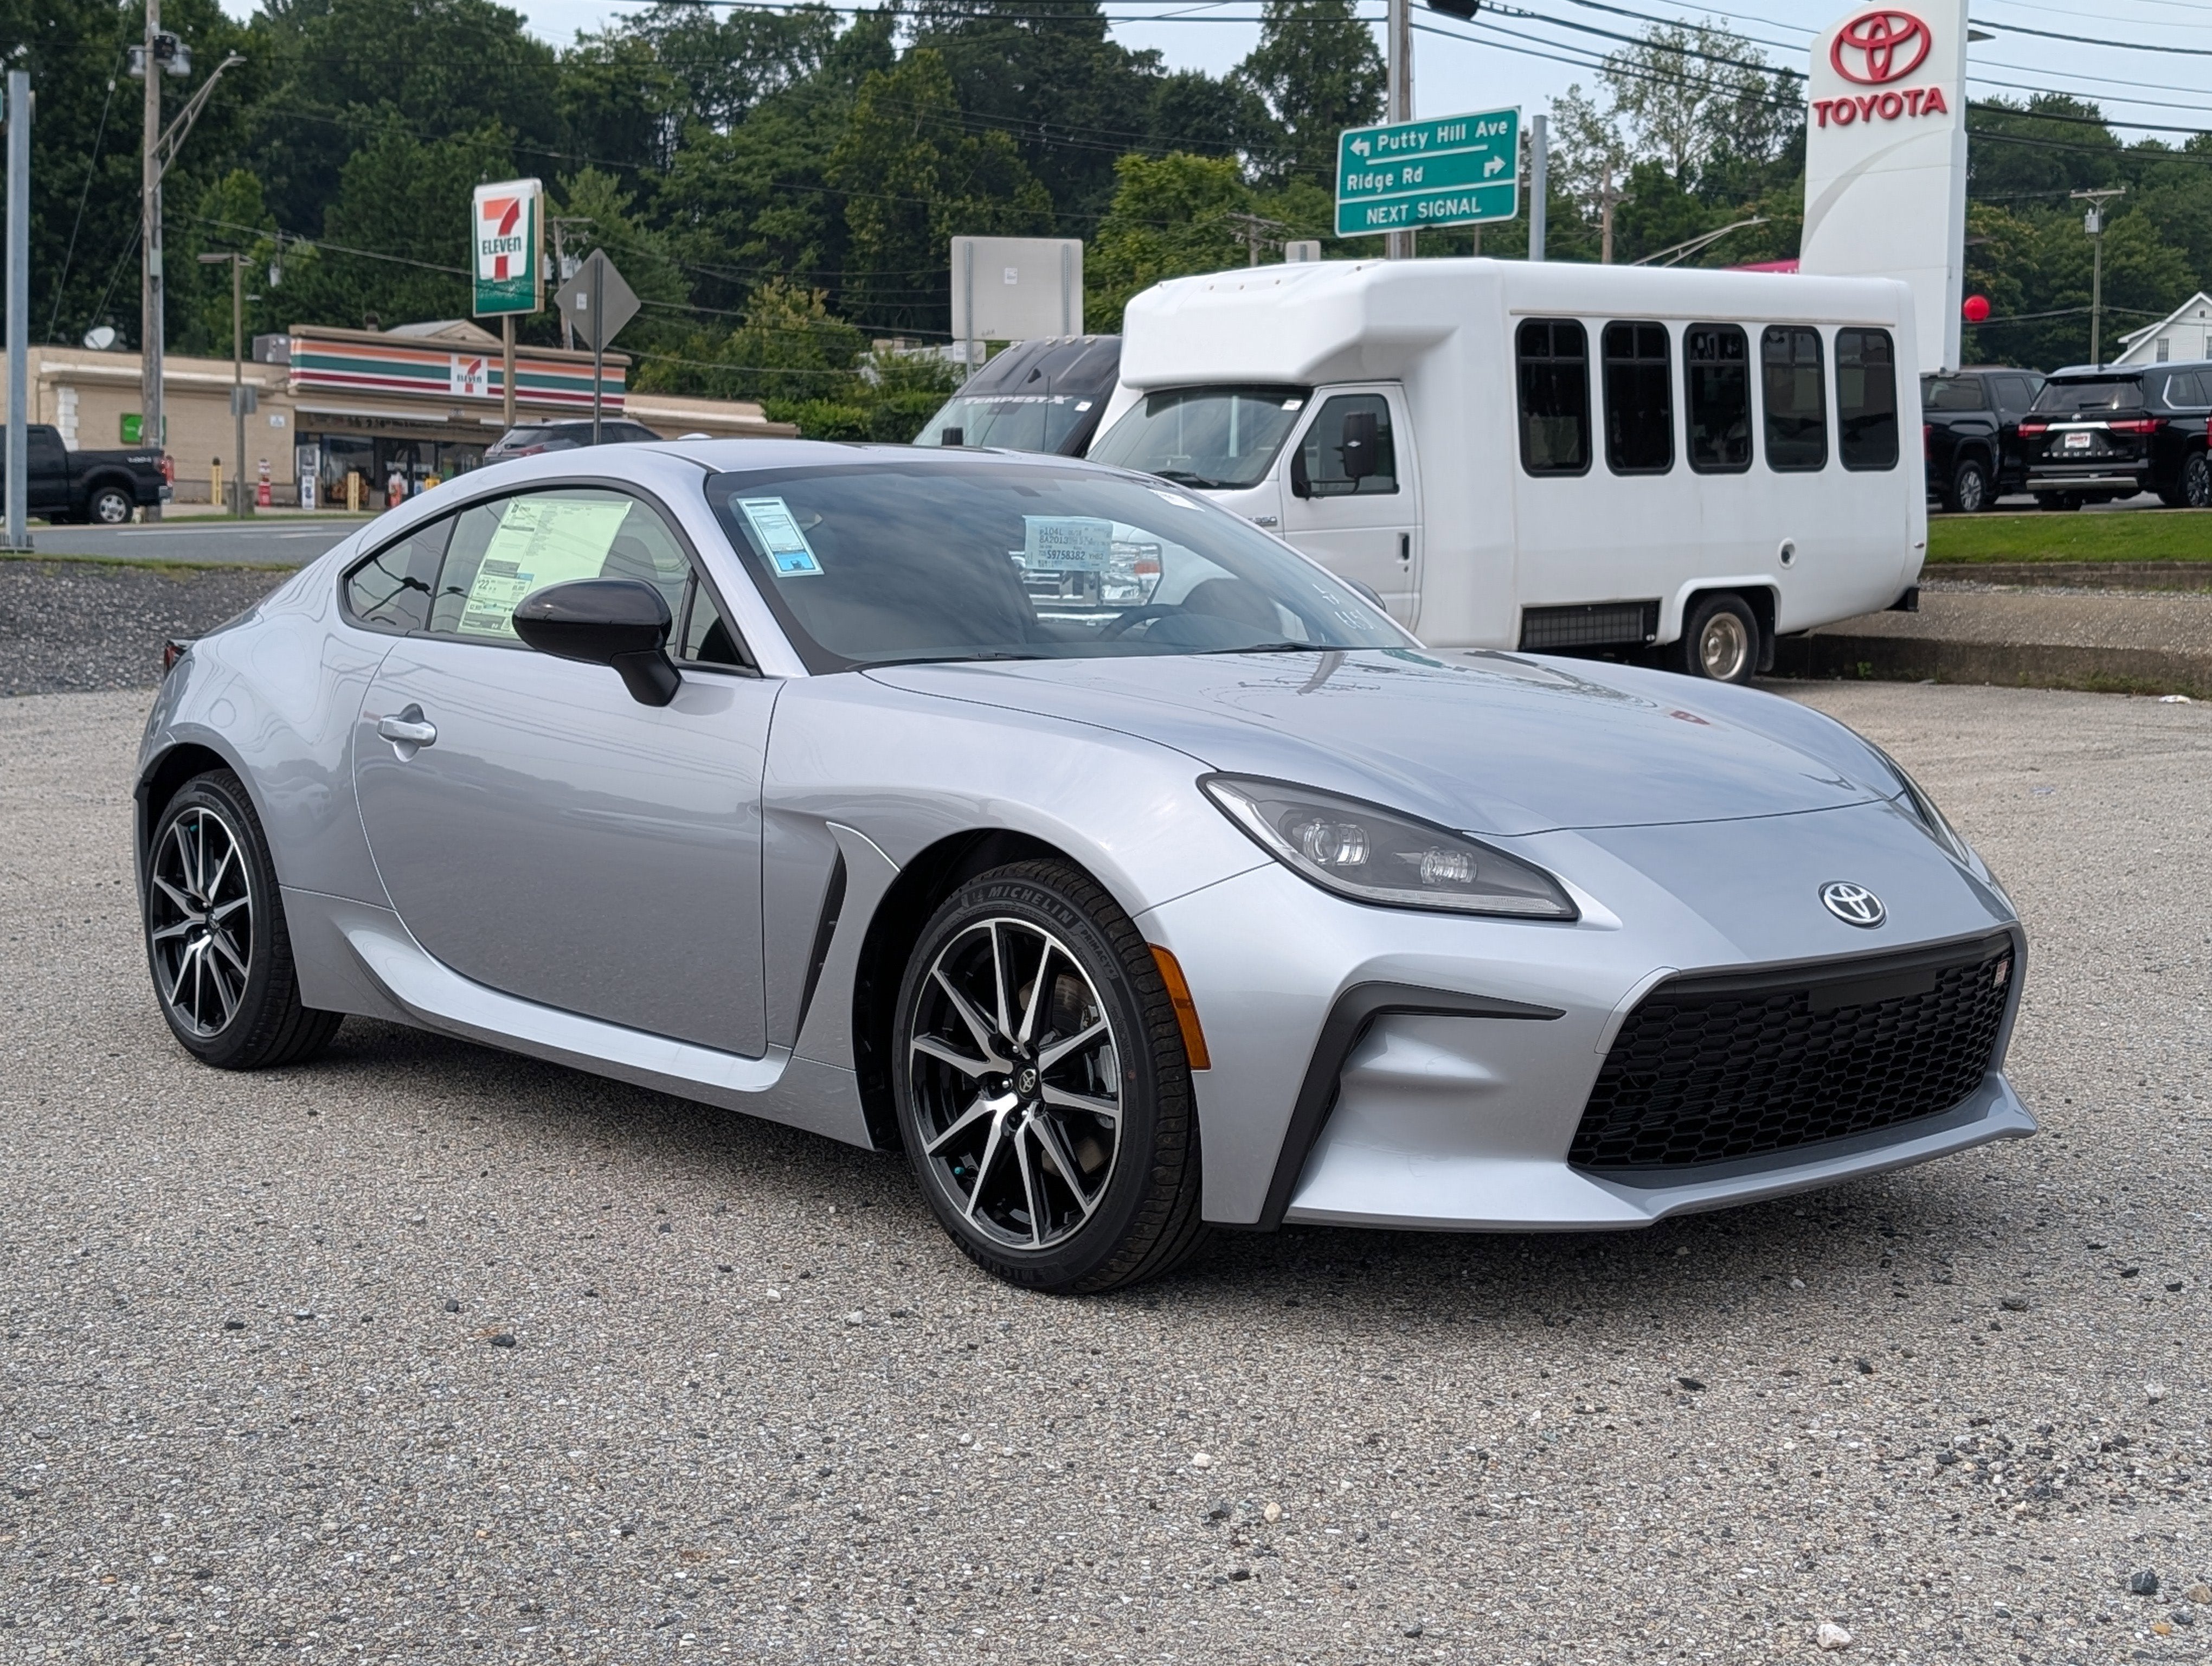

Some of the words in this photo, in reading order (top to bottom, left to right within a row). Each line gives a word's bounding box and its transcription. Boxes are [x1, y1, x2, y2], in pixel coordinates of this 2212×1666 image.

[1812, 87, 1948, 128] TOYOTA
[1378, 130, 1429, 151] Putty
[1437, 124, 1467, 143] Hill
[1475, 119, 1508, 138] Ave
[1347, 172, 1394, 193] Ridge
[1403, 166, 1424, 184] Rd
[1366, 204, 1408, 225] NEXT
[1417, 197, 1482, 219] SIGNAL
[988, 886, 1074, 924] MICHELIN
[1081, 929, 1111, 968] PRIMACY
